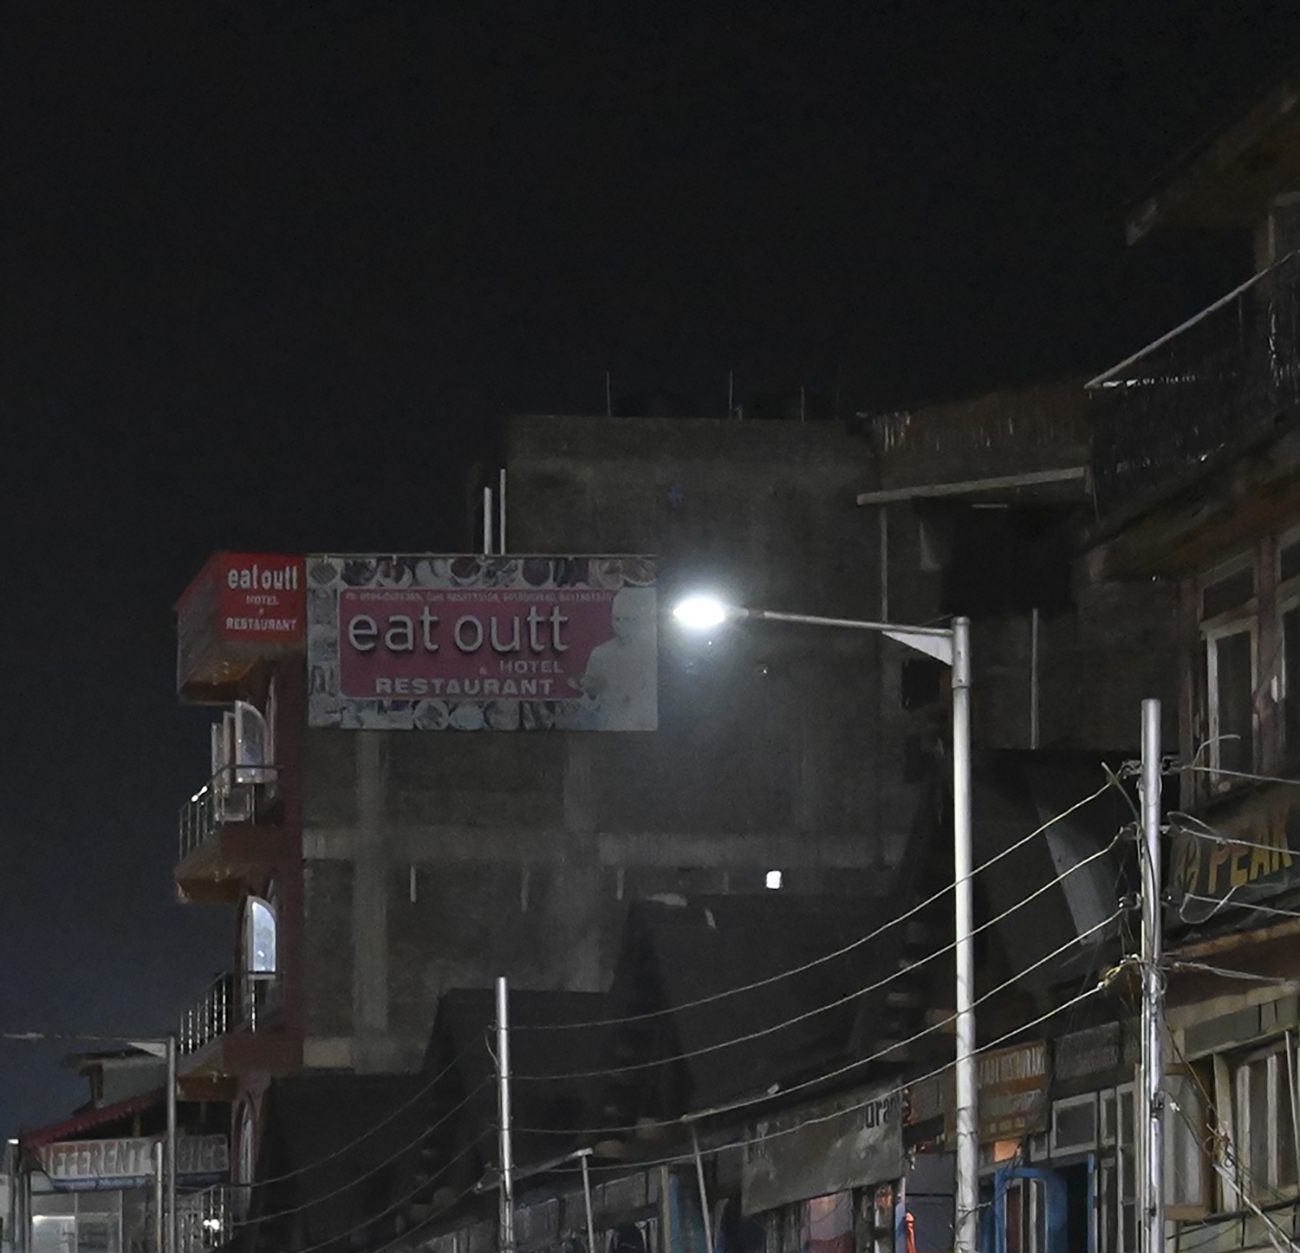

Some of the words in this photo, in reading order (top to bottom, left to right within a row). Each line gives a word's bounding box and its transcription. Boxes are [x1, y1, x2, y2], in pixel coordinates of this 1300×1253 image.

[348, 606, 439, 651] eat
[454, 606, 569, 652] outt
[500, 660, 564, 674] HOTEL
[375, 678, 554, 696] RESTAURANT
